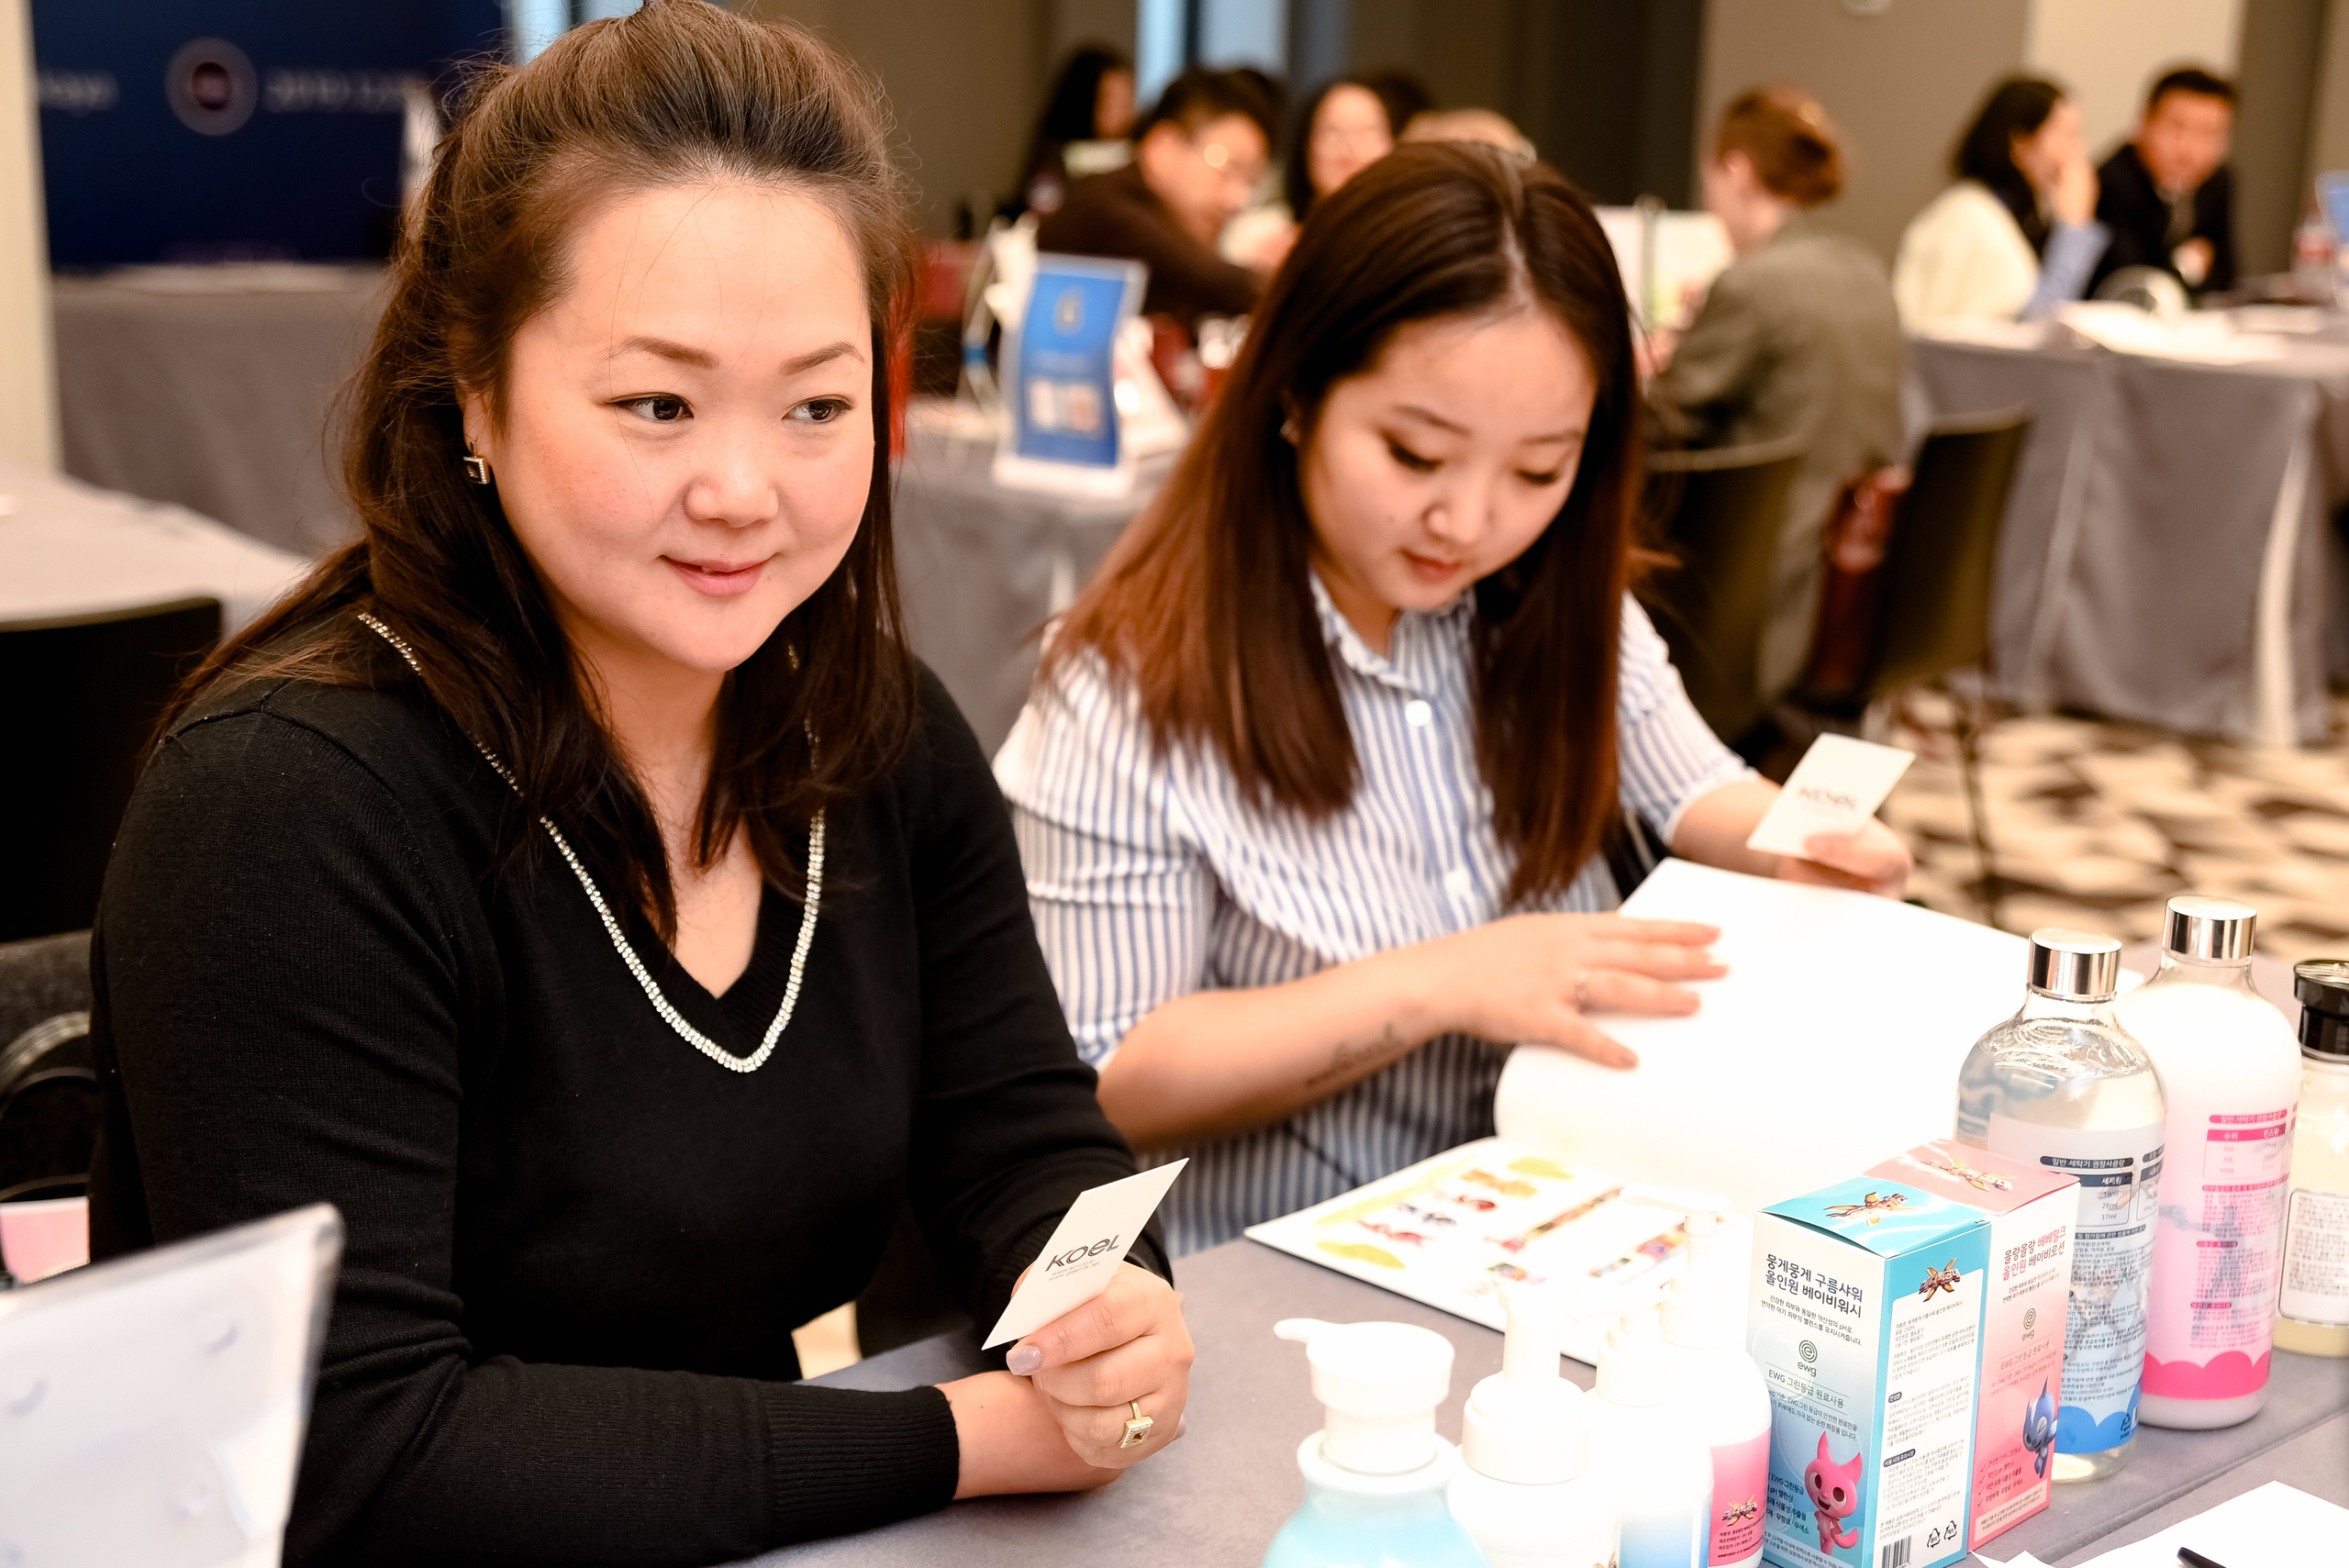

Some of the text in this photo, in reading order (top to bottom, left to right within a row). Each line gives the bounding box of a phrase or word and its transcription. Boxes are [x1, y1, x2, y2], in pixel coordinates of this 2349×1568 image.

[2052, 1158, 2067, 1167] 일반
[2068, 1160, 2090, 1168] 세탁기
[2037, 1226, 2065, 1247] 베베밀크
[2003, 1240, 2065, 1281] 올인원 베이비로션
[1766, 1253, 1863, 1303] 뭉게뭉게 구름샤워
[1765, 1270, 1862, 1318] 올인원 베이비워시
[1761, 1300, 1776, 1311] 연약한
[1776, 1307, 1787, 1316] 아기
[1787, 1311, 1802, 1322] 피부의
[1804, 1318, 1823, 1331] 밸런스를
[1770, 1295, 1852, 1334] 건강한 피부와 동일한 약산성의 pH로
[2022, 1329, 2034, 1341] ewg
[1797, 1362, 1817, 1377] ewg
[2001, 1359, 2012, 1370] EWG
[1768, 1370, 1786, 1383] EWG
[1787, 1377, 1814, 1396] 그린등급
[1816, 1389, 1844, 1409] 원료사용
[1787, 1397, 1798, 1407] EWG
[1798, 1403, 1808, 1411] 그린
[1809, 1407, 1822, 1417] 등급의
[1823, 1412, 1838, 1423] 안전한
[1838, 1418, 1857, 1431] 원료만을
[1771, 1473, 1804, 1496] EWG 그린등급
[1778, 1489, 1794, 1503] 밸런싱
[1776, 1499, 1791, 1514] 식물성
[1791, 1509, 1807, 1521] 추출물
[1776, 1513, 1791, 1525] 무향료
[1794, 1521, 1809, 1534] 무색소
